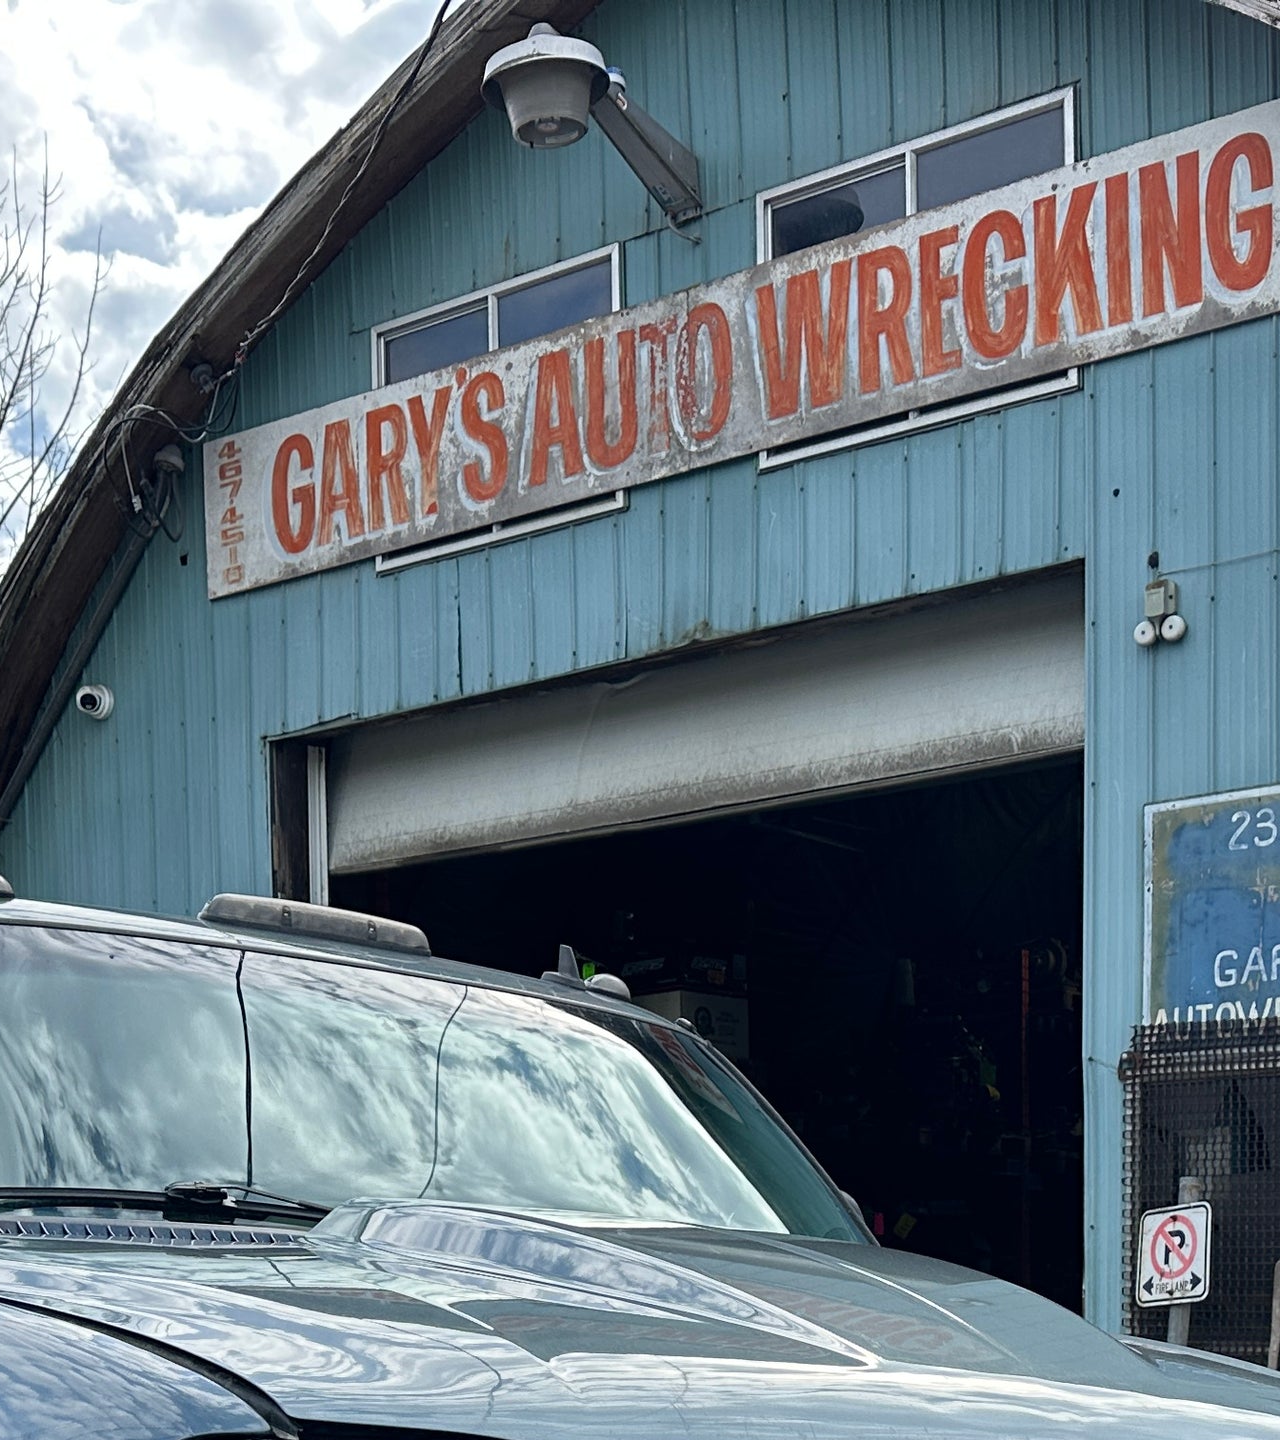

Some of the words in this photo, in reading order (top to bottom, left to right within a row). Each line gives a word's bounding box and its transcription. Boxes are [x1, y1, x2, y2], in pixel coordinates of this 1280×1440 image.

[271, 366, 509, 555] GARY'S
[528, 301, 733, 487] AUTO
[755, 132, 1274, 420] WRECKING
